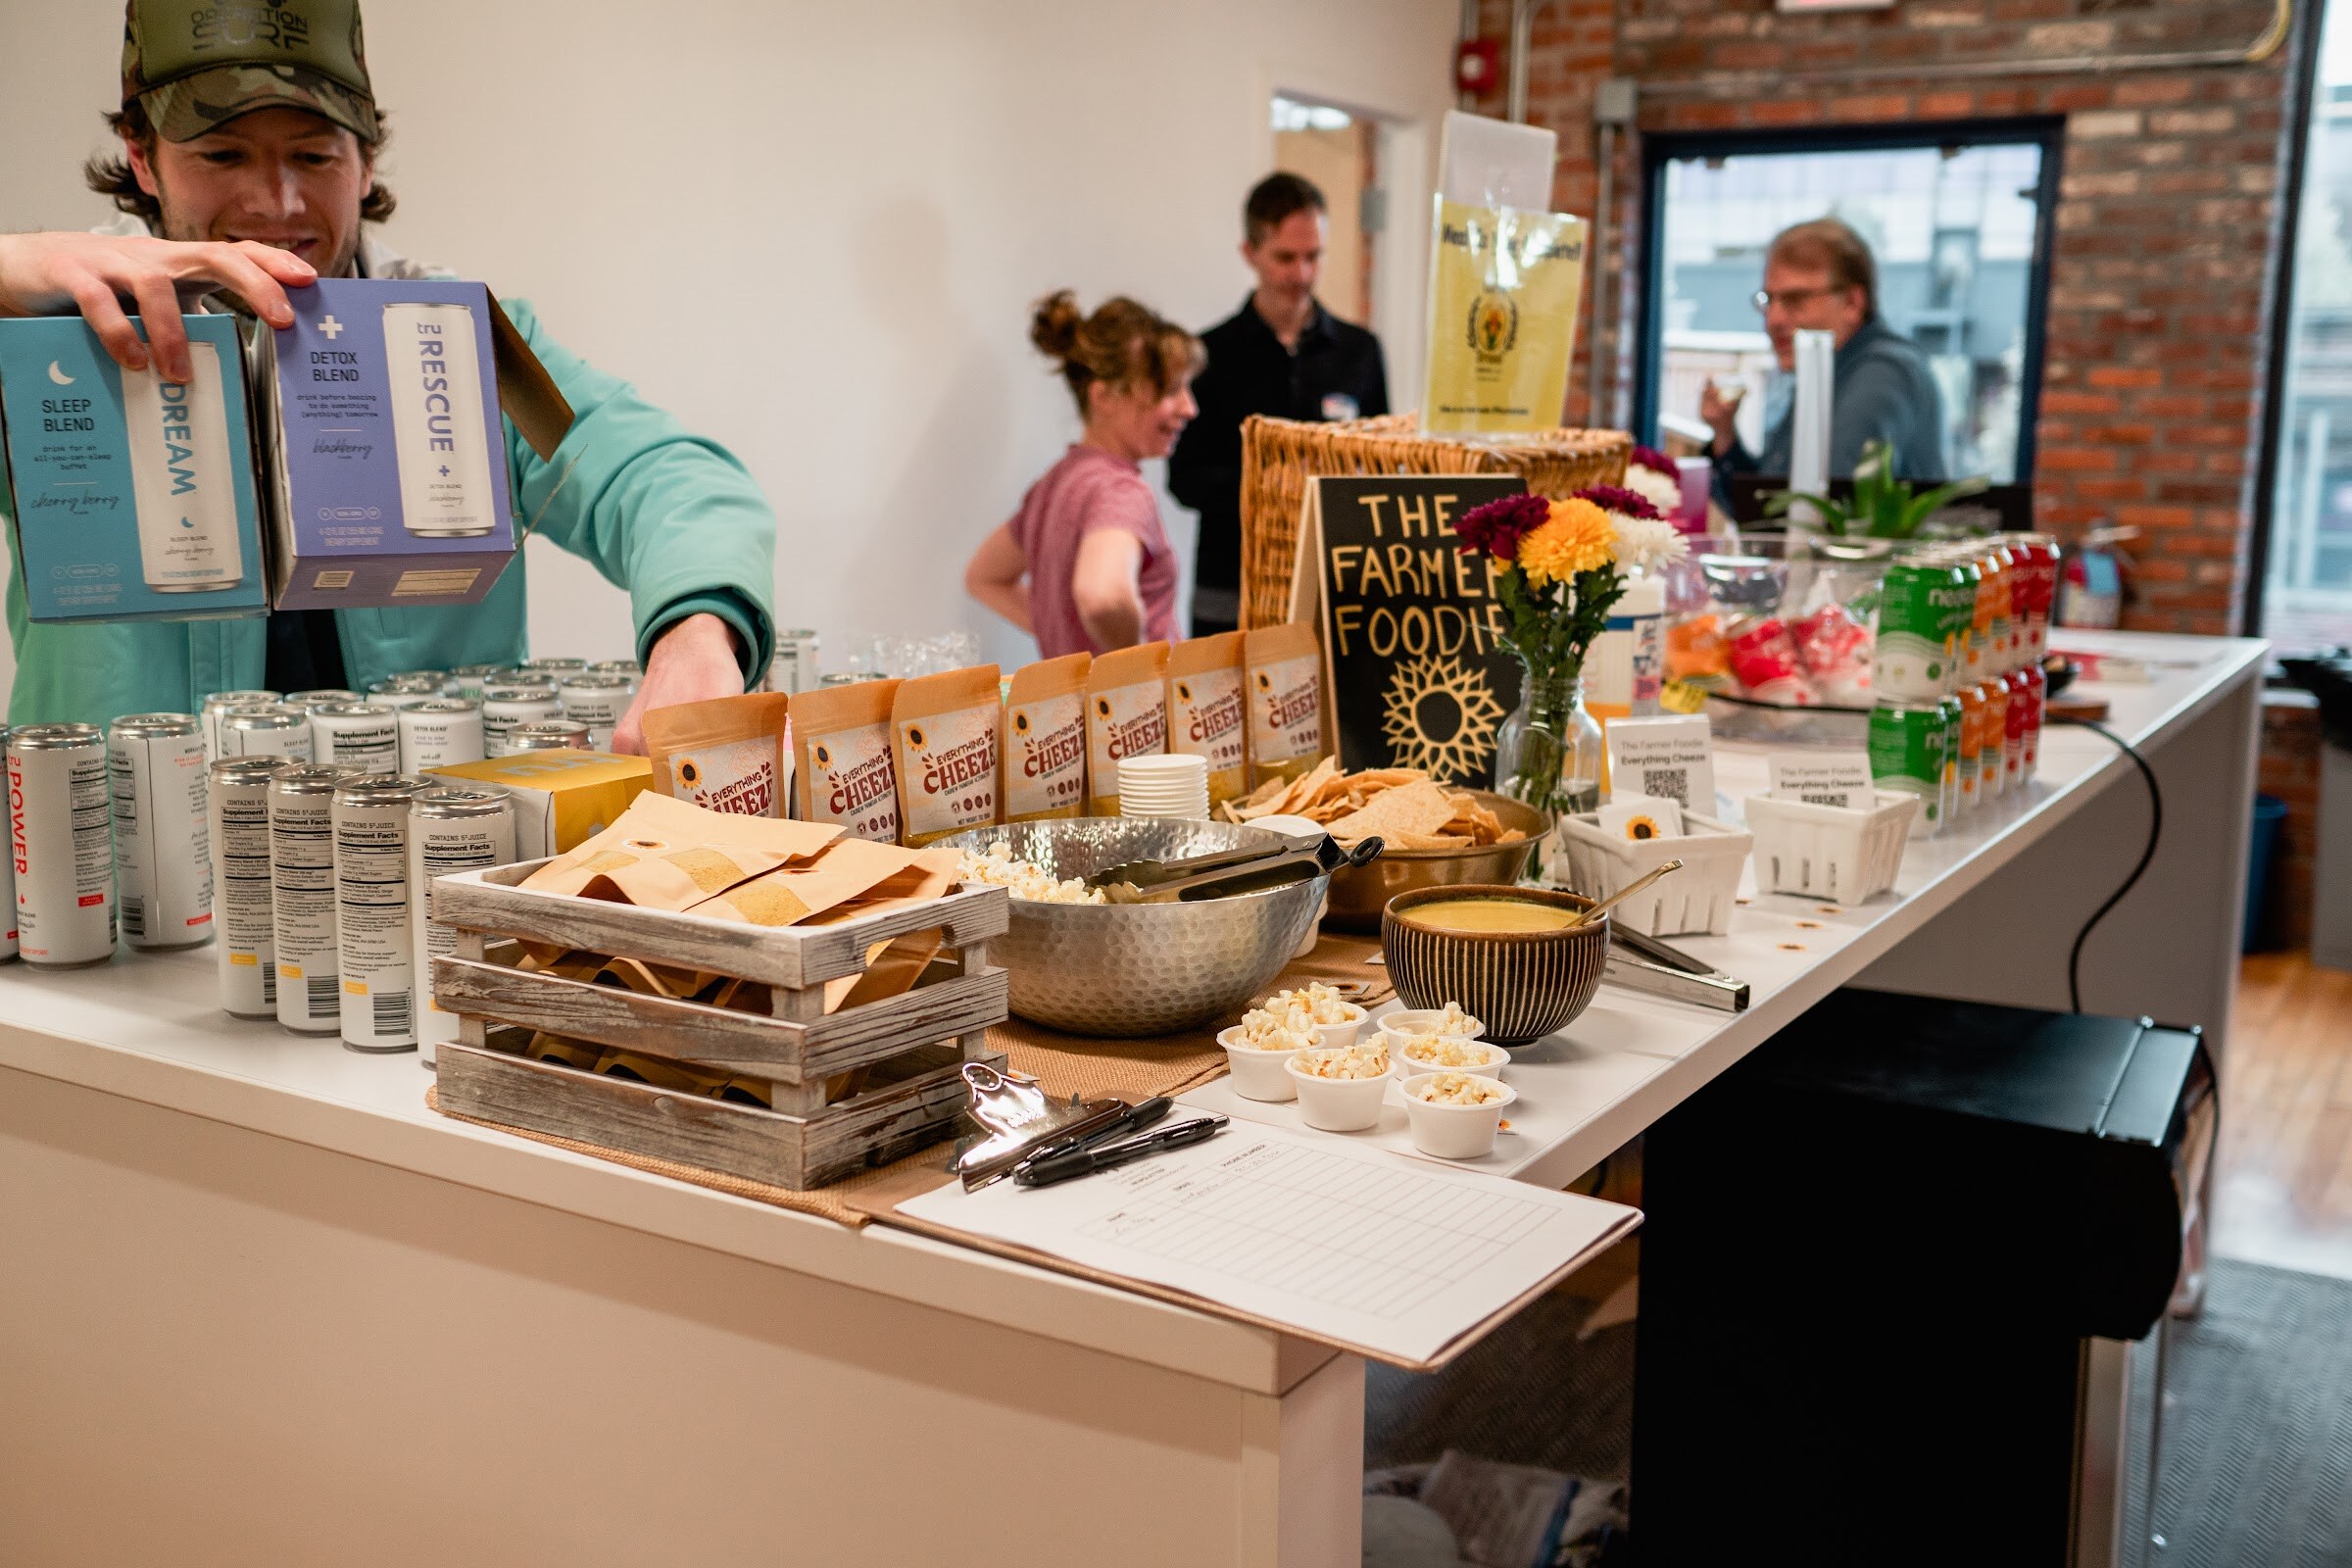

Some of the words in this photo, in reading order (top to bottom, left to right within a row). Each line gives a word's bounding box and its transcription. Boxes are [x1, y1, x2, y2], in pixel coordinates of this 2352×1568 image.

[310, 351, 359, 365] DETOX
[313, 368, 360, 382] BLEND
[41, 399, 92, 414] SLEEP
[418, 340, 455, 452] RESCUE
[43, 417, 95, 432] BLEND
[159, 382, 197, 496] DREAM
[1357, 493, 1459, 538] THE
[333, 729, 379, 740] Supplement
[1119, 708, 1157, 735] EVERYTHING
[1189, 700, 1244, 743] CHEEZE
[1037, 723, 1076, 751] EVERYTHING
[1107, 714, 1166, 761] CHEEZE
[1622, 740, 1639, 751] The
[936, 737, 986, 765] EVERYTHING
[1023, 729, 1085, 778] CHEEZE
[1620, 754, 1671, 766] Everything
[1672, 753, 1706, 763] Cheeze
[842, 754, 885, 785] EVERYTHING
[923, 743, 996, 795] CHEEZE
[711, 771, 762, 805] EVERYTHING
[712, 777, 773, 816] HEEZE
[1780, 780, 1829, 790] Everything
[1830, 778, 1865, 788] Cheeze
[9, 770, 29, 879] POWER
[273, 817, 310, 826] Supplement
[338, 829, 375, 839] Supplement
[341, 820, 368, 829] CONTAINS
[424, 844, 468, 853] Supplement
